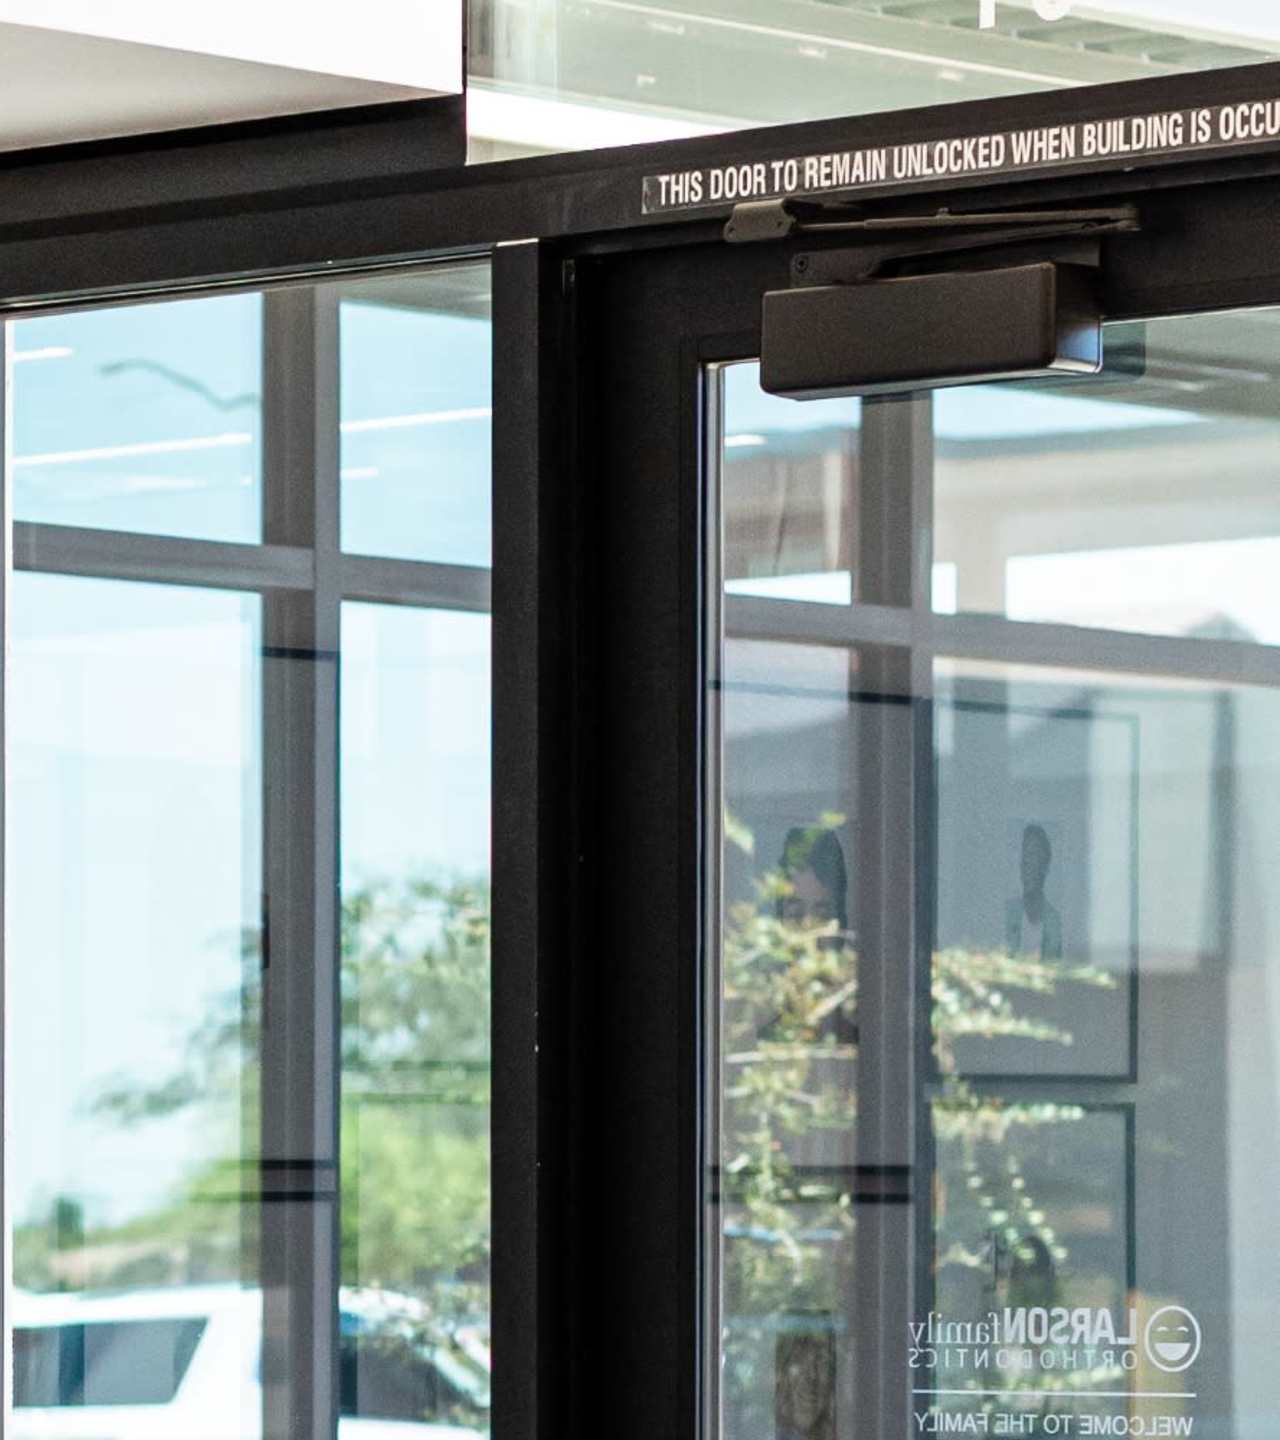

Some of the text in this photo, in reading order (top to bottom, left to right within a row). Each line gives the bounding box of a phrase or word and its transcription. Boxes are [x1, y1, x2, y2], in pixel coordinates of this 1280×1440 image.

[658, 101, 1280, 206] THIS DOOR TO REMAIN UNLOCKED WHEN BUILDING IS OCCU
